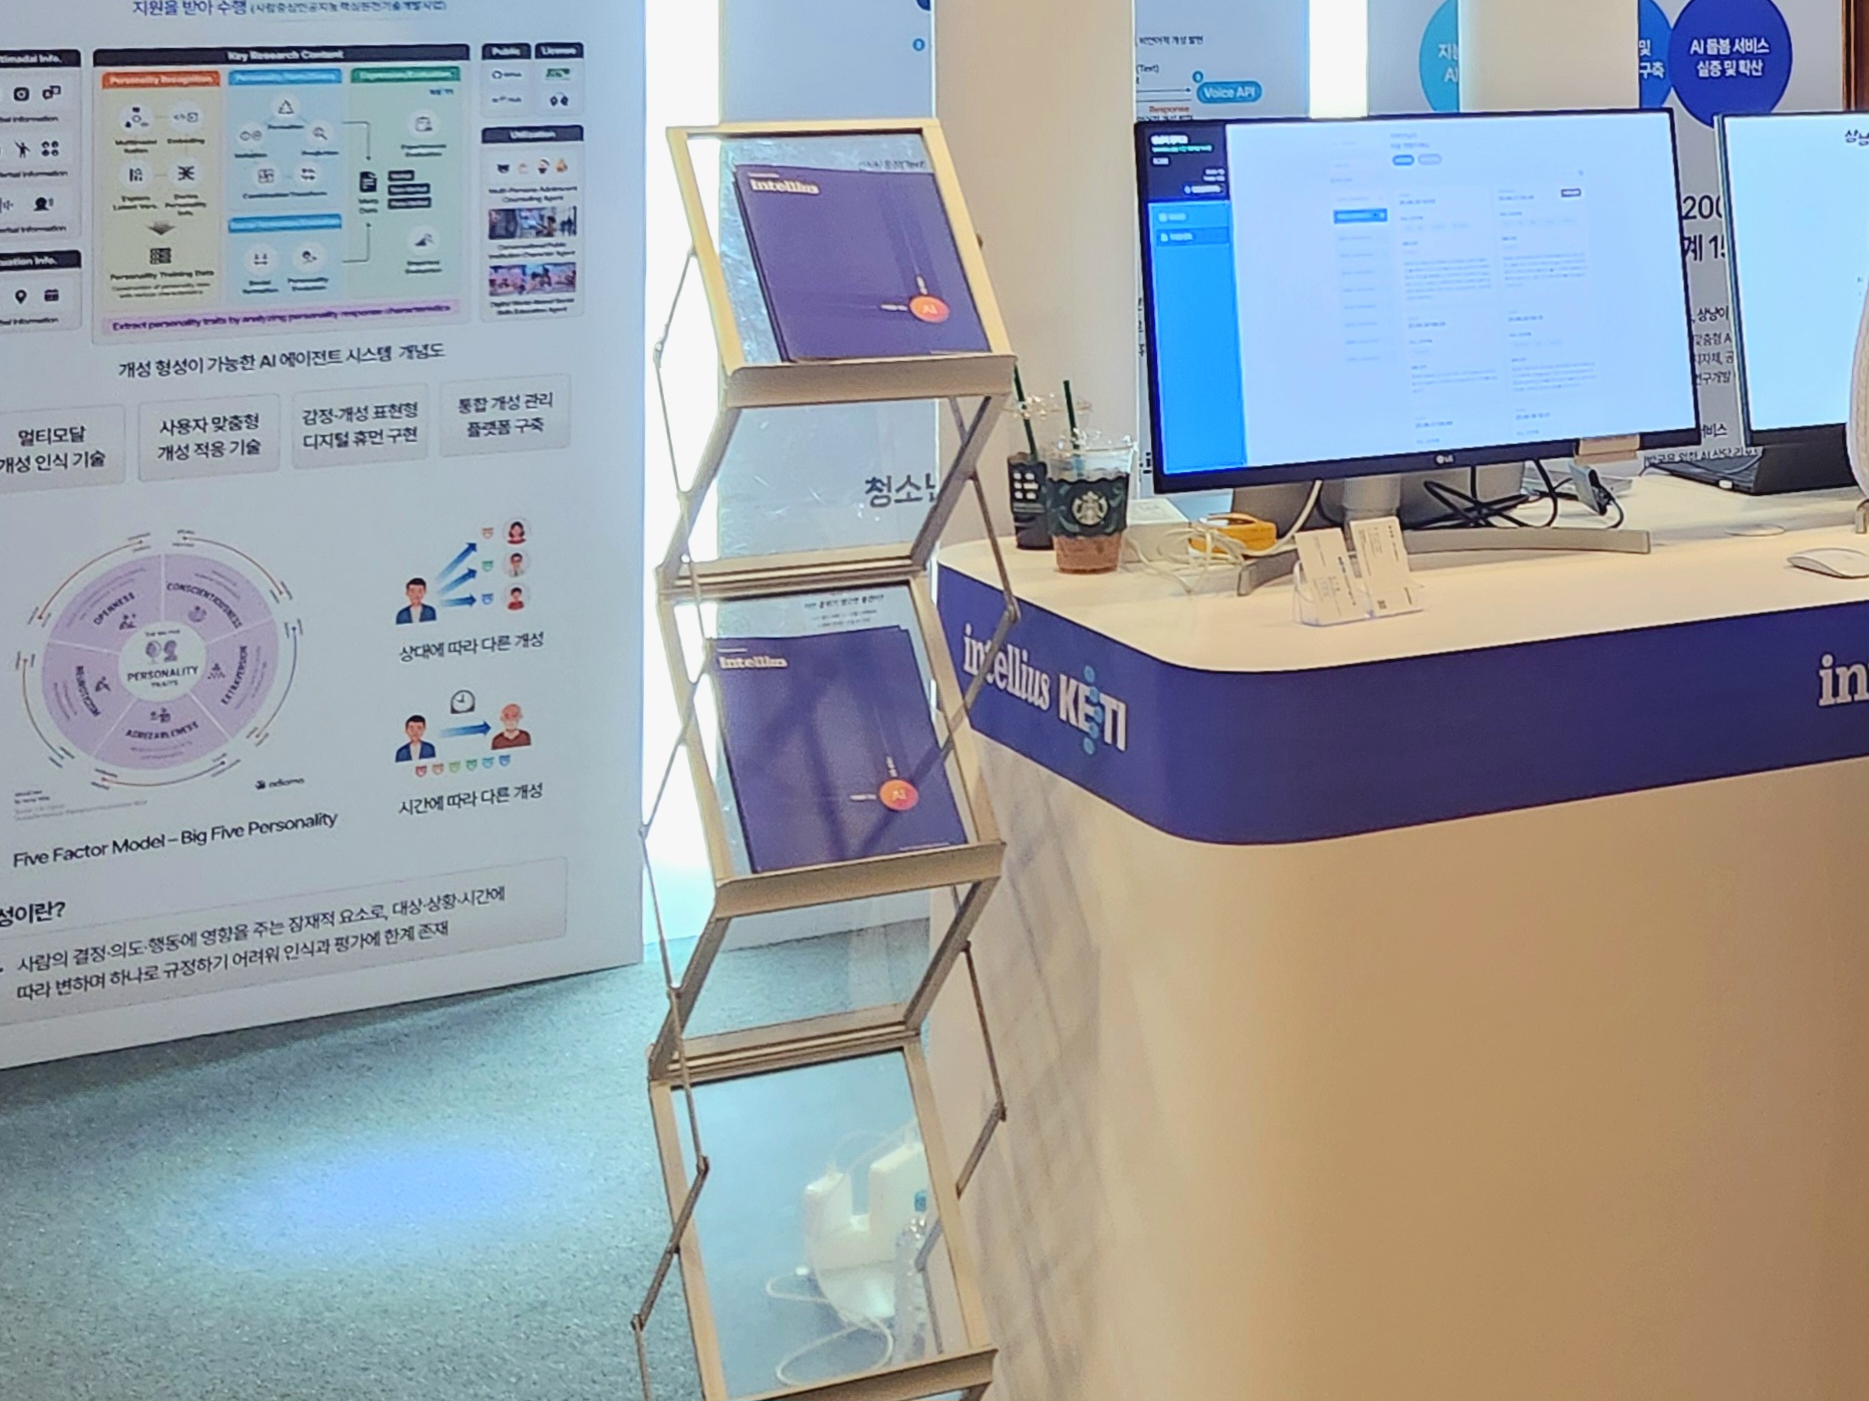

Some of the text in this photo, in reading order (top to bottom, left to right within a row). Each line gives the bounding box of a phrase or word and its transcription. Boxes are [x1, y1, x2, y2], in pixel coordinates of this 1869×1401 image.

[132, 0, 247, 17] 지원을 받아 수행
[1690, 38, 1704, 55] AI
[1733, 36, 1771, 54] 서비스
[1724, 59, 1737, 77] 및
[1203, 85, 1256, 99] Voice API
[118, 342, 447, 379] 개성 형성이 가능한 AI 에이전트 시스템 개념도
[371, 401, 419, 421] 표현형
[457, 391, 554, 415] 통합 개성 관리
[18, 425, 87, 447] 멀티모달
[159, 412, 260, 438] 사용자 맞춤형
[514, 416, 545, 435] 구축
[157, 443, 191, 462] 개성
[229, 437, 262, 457] 기술
[302, 426, 418, 450] 디지털 휴먼 구현
[0, 449, 106, 475] 개성 인식 기술
[399, 631, 545, 663] 상대에 따라 다른 개성
[127, 665, 199, 682] PERSONALITY
[963, 623, 1128, 755] intellius KETI
[399, 782, 544, 816] 시간에 따라 다른 개성
[12, 811, 339, 869] Five Factor Model Big Five Personality
[17, 950, 69, 974] 사람의
[199, 923, 250, 946] 영향을
[253, 918, 286, 939] 주는
[288, 910, 336, 935] 잠재적
[16, 919, 449, 1000] 따라 변하며 하나로 규정하기 어려워 인식과 평가에 한계 존재
